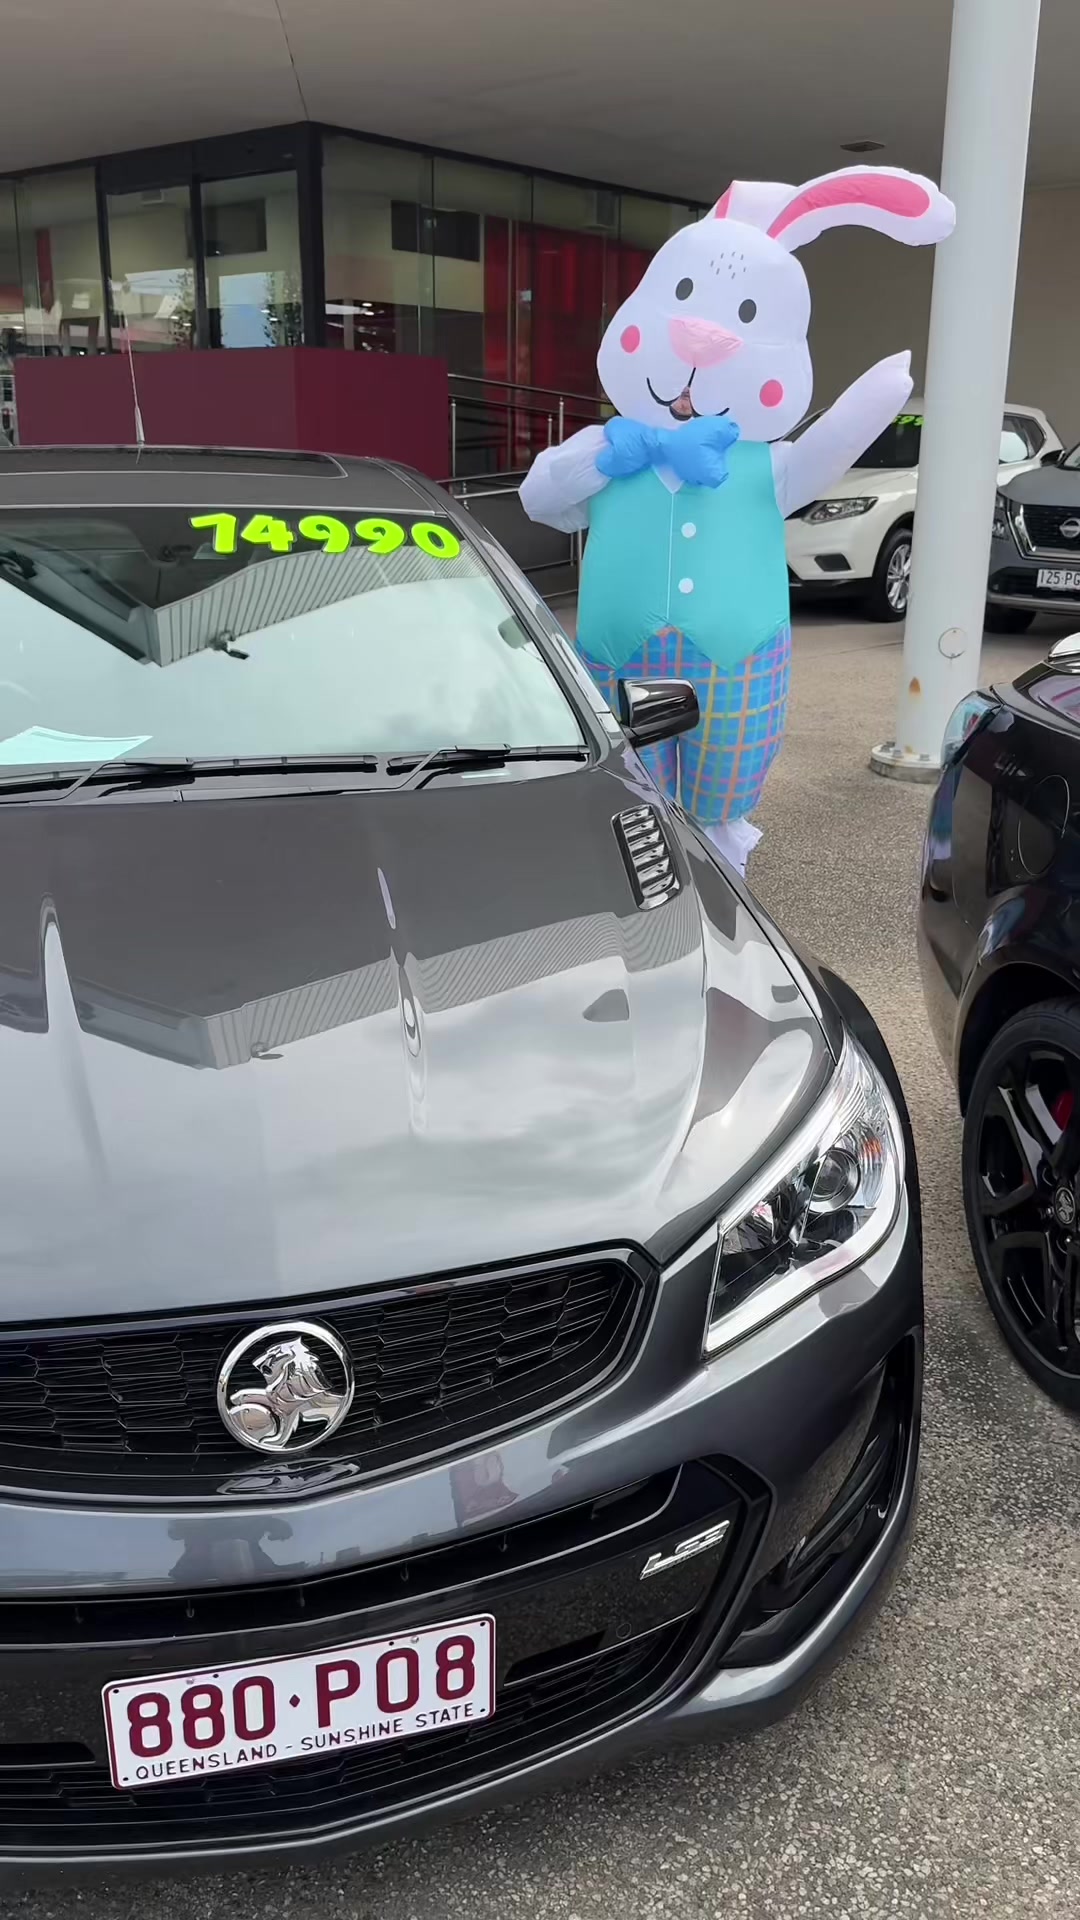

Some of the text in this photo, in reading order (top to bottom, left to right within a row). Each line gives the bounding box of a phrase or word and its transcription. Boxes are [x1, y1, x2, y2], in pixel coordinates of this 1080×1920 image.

[190, 512, 461, 560] 74990
[136, 1742, 277, 1780] QUEENSLAND
[300, 1717, 403, 1751] SUNSHINE
[415, 1702, 474, 1728] STATE
